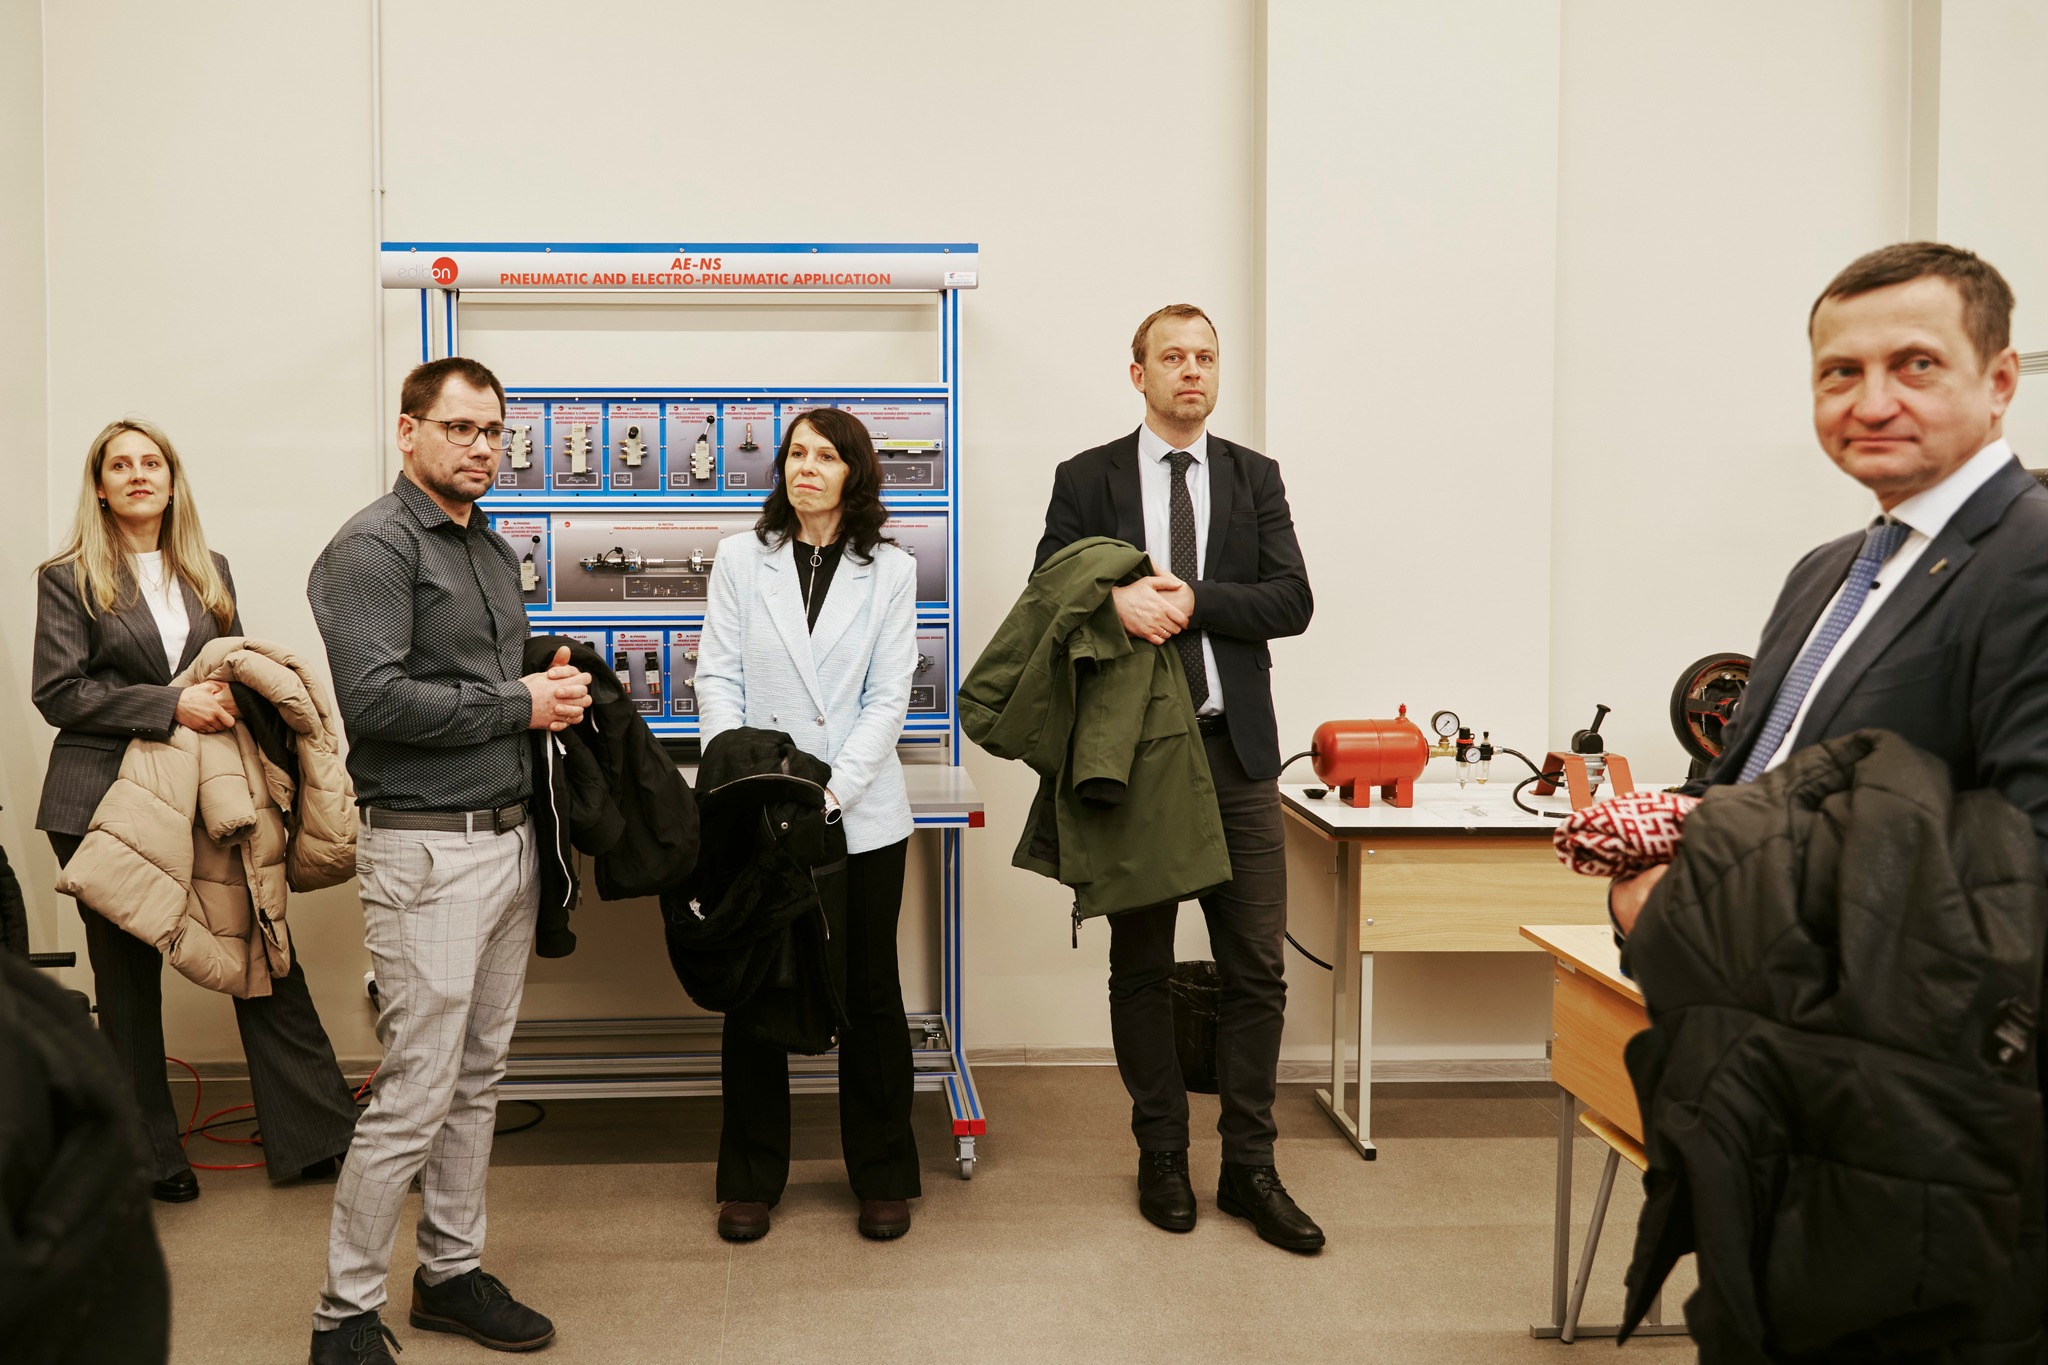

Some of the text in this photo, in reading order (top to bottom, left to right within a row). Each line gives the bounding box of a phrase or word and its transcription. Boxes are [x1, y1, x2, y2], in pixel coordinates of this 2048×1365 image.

[397, 263, 451, 279] edibon
[670, 257, 722, 271] AE-NS
[500, 273, 891, 285] PNEUMATIC AND ELECTRO-PNEUMATIC APPLICATION
